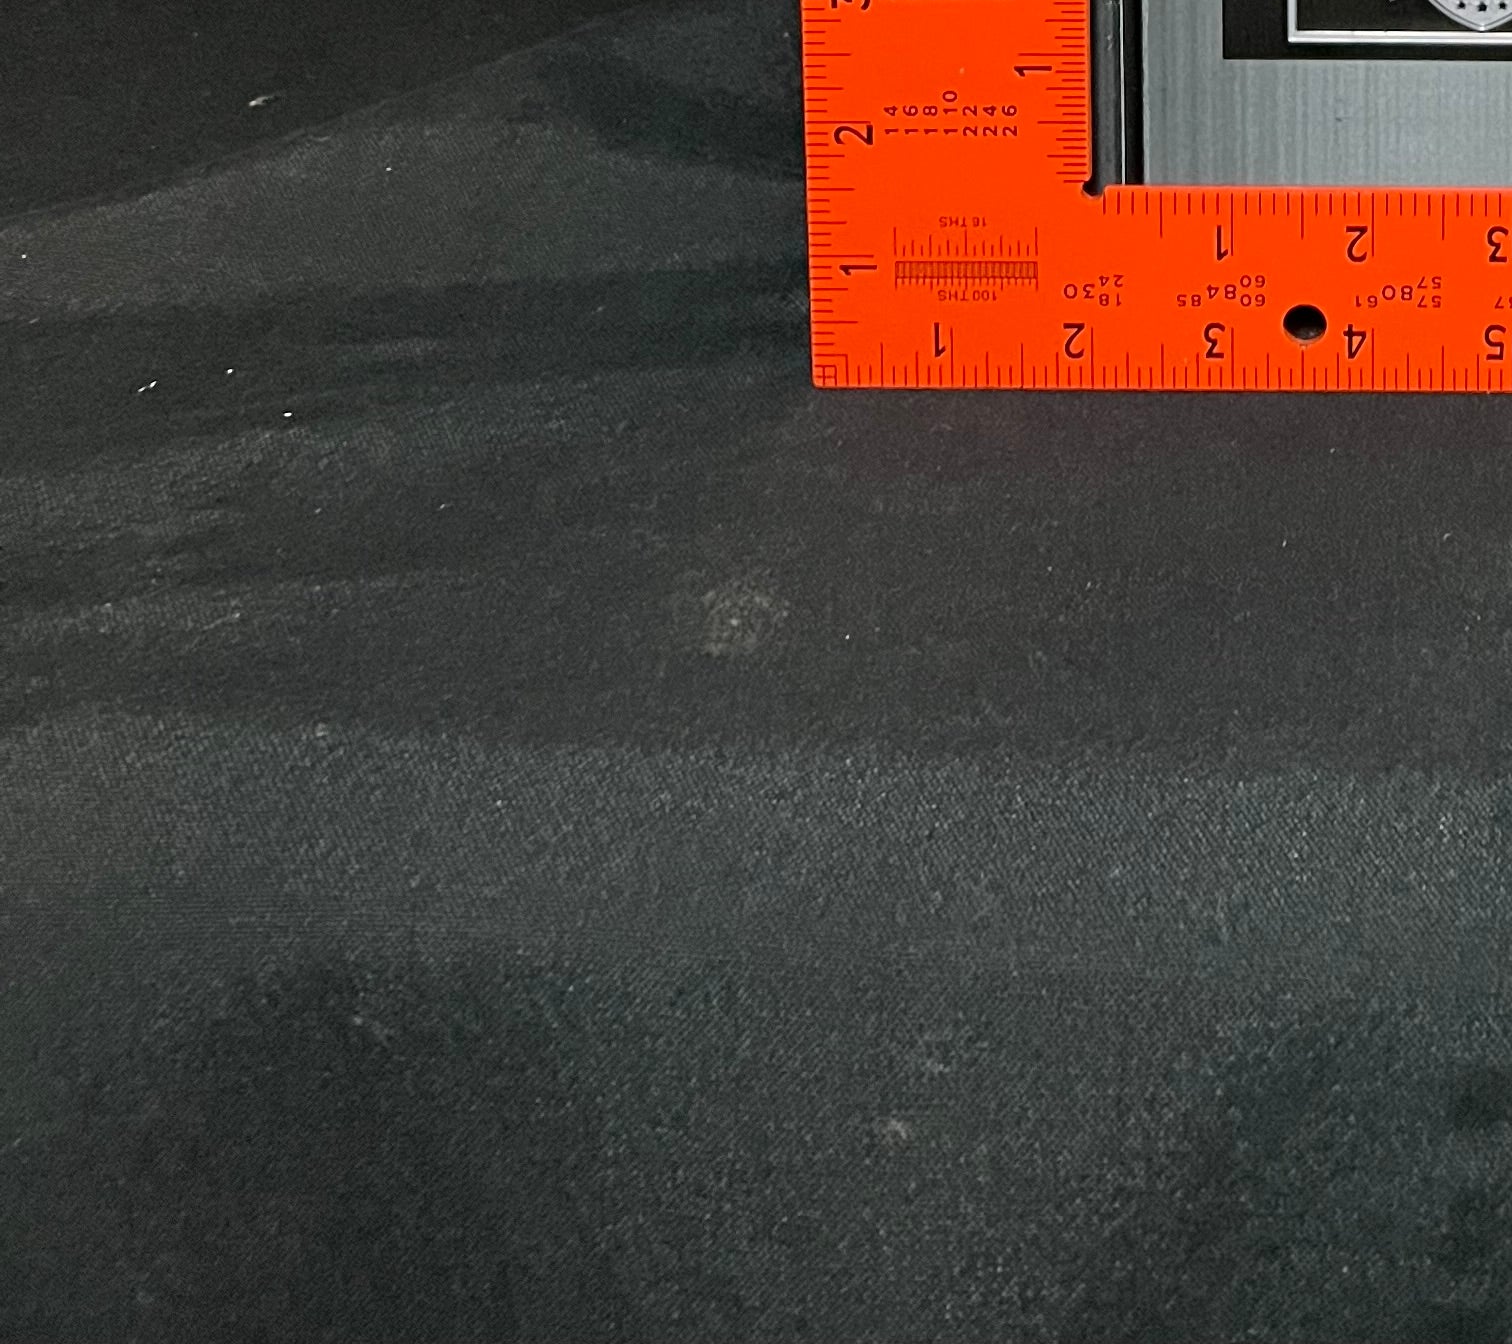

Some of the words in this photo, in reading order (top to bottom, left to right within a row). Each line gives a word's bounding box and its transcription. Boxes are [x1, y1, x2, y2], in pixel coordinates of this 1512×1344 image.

[1014, 66, 1052, 77] 1
[884, 106, 897, 116] 4
[1002, 105, 1017, 116] 6
[834, 125, 873, 145] 2
[1003, 126, 1017, 136] 2
[1217, 225, 1228, 261] 1
[1346, 226, 1368, 262] 2
[1487, 226, 1509, 263] 3
[839, 265, 877, 276] 1
[934, 322, 946, 357] 1
[1063, 323, 1085, 359] 2
[1204, 323, 1225, 358] 3
[1343, 324, 1366, 359] 4
[1485, 325, 1506, 360] 5
